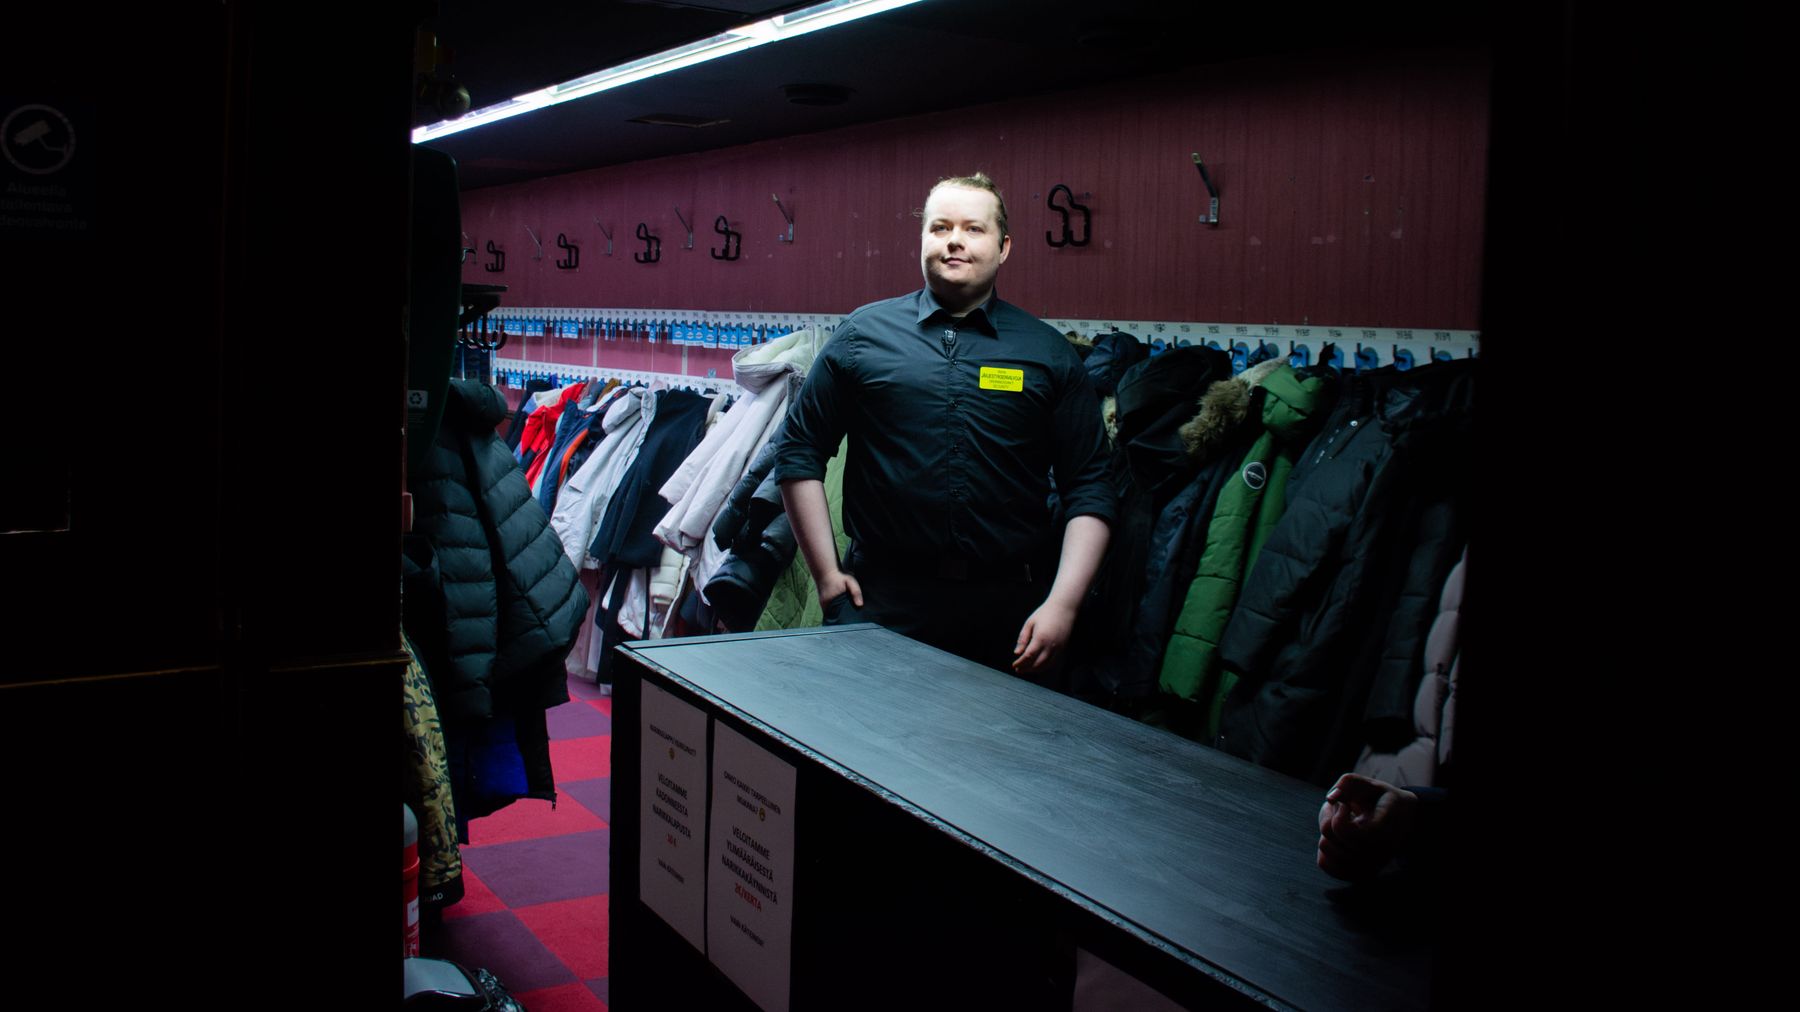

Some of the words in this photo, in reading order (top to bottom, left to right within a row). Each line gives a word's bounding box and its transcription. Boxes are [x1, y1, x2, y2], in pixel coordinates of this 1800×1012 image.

[726, 839, 774, 882] YLIMÄÄRÄISESTÄ
[732, 825, 770, 860] VELOITAMME
[721, 854, 778, 905] NARIKKAKÄYNNISTÄ
